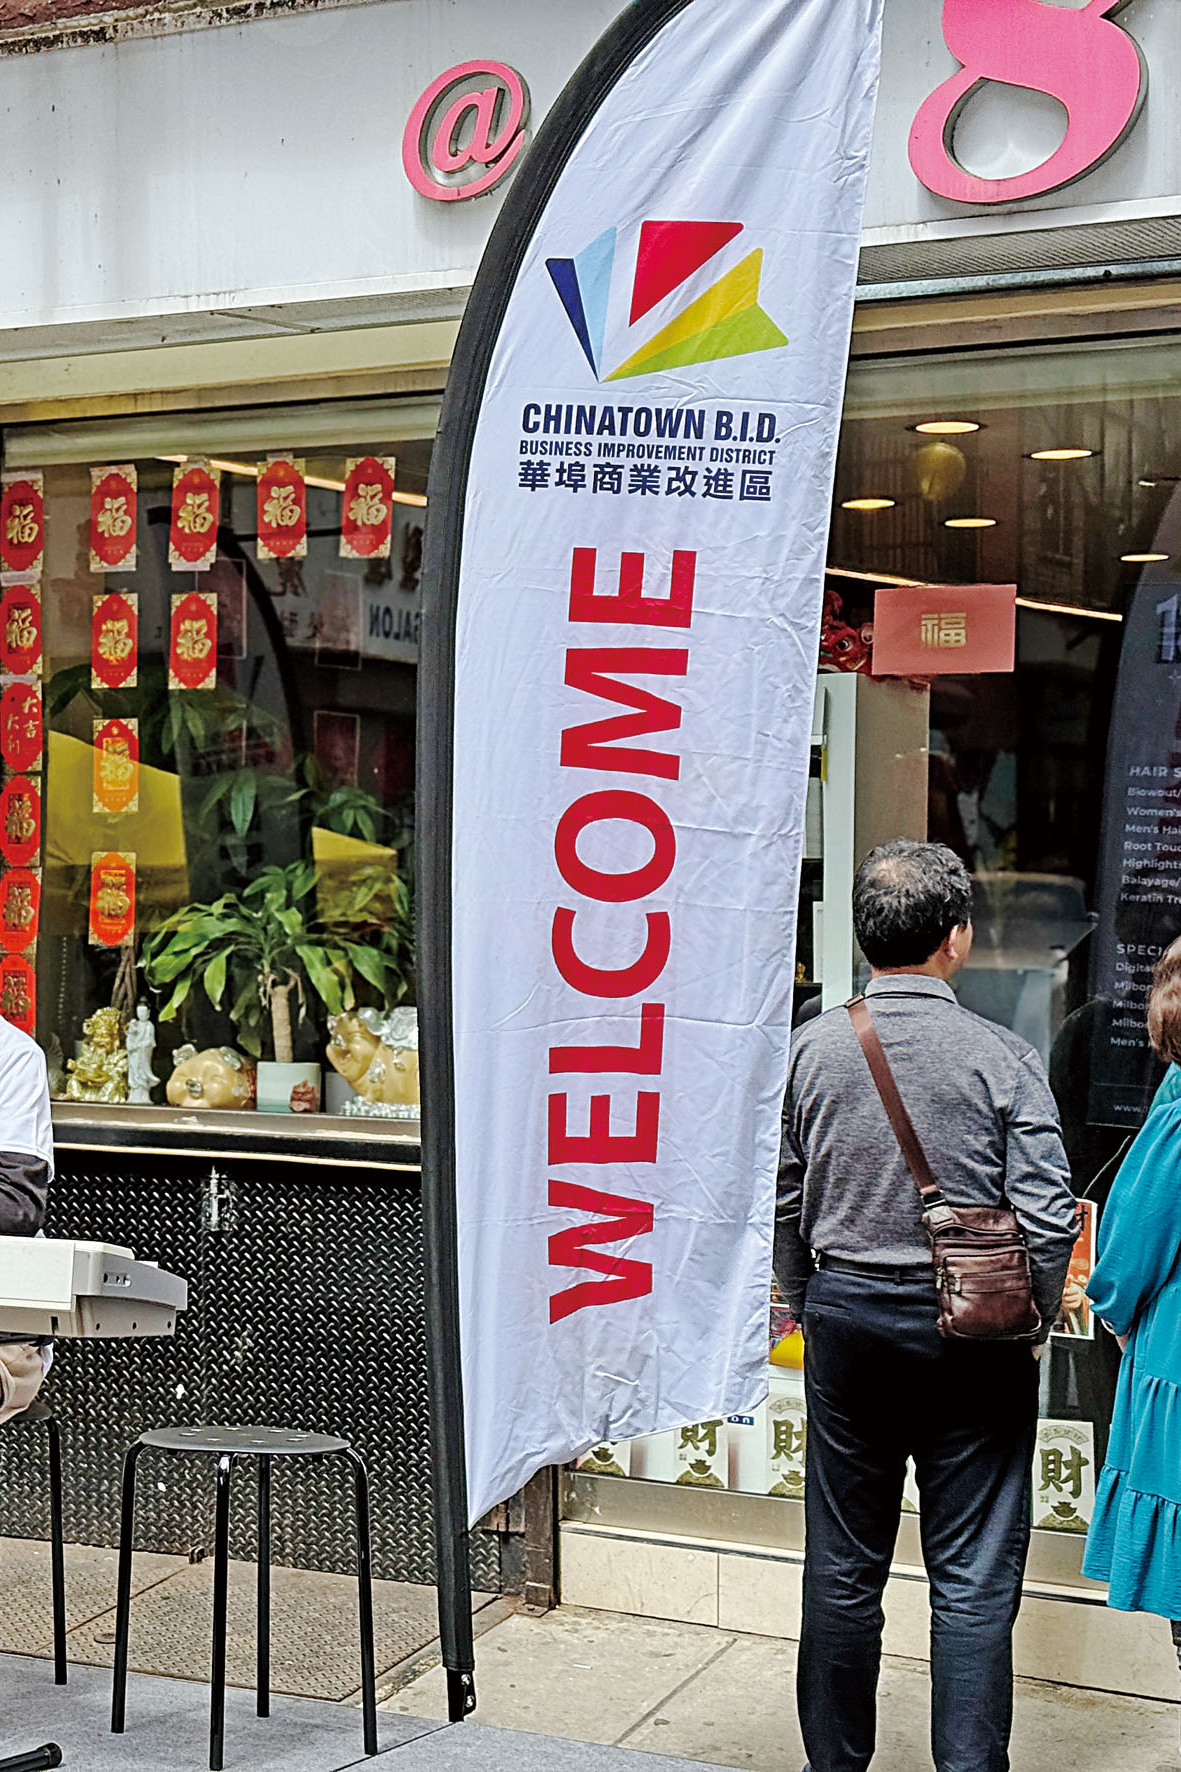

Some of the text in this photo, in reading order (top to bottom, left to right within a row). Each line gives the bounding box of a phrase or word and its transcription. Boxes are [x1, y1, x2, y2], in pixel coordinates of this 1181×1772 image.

[402, 60, 526, 202] @
[522, 403, 781, 444] CHINATOWN B.I.D.
[519, 440, 777, 466] BUSINESS IMPROVEMENT DISTRICT
[518, 459, 773, 502] 華埠商業改進區
[6, 504, 39, 544] 福
[98, 497, 132, 537] 福
[177, 492, 214, 533] 福
[263, 485, 301, 528] 福
[348, 484, 387, 526] 福
[6, 608, 37, 648] 福
[98, 619, 133, 659] 福
[176, 618, 212, 660] 福
[921, 612, 967, 648] 福
[1156, 593, 1181, 662] 1
[1129, 766, 1168, 777] HAIR
[1123, 841, 1152, 851] Root
[1125, 824, 1159, 834] Men's
[1120, 893, 1163, 903] Keratin
[548, 546, 697, 1325] WELCOME
[1116, 943, 1162, 956] SPECI
[1115, 962, 1154, 974] Digita
[1038, 1445, 1090, 1499] 財
